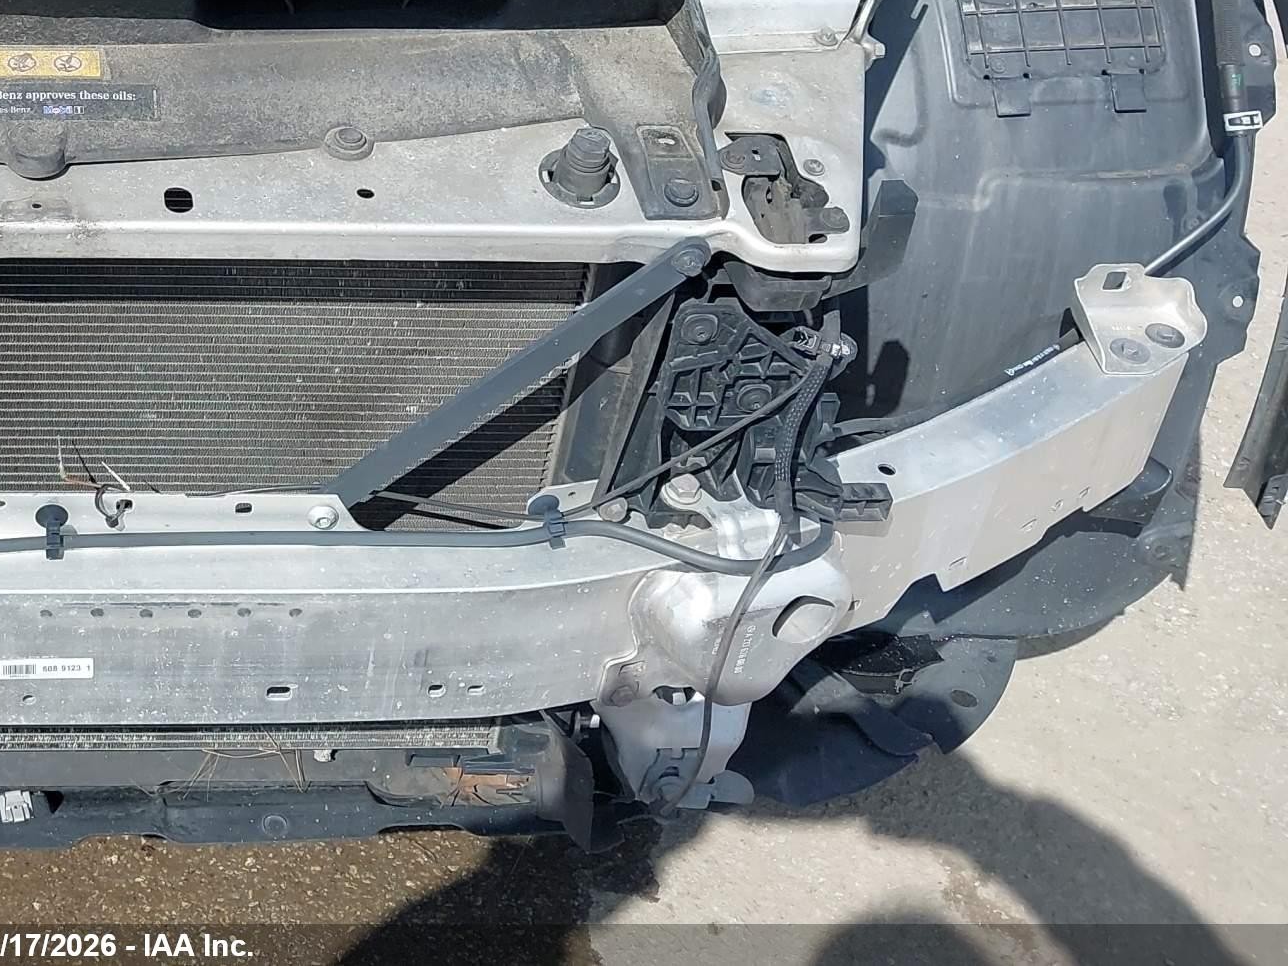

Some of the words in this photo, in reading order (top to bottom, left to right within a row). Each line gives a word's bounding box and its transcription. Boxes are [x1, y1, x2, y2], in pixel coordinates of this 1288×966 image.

[25, 91, 77, 102] approves
[79, 90, 110, 101] these
[112, 90, 137, 102] oils:
